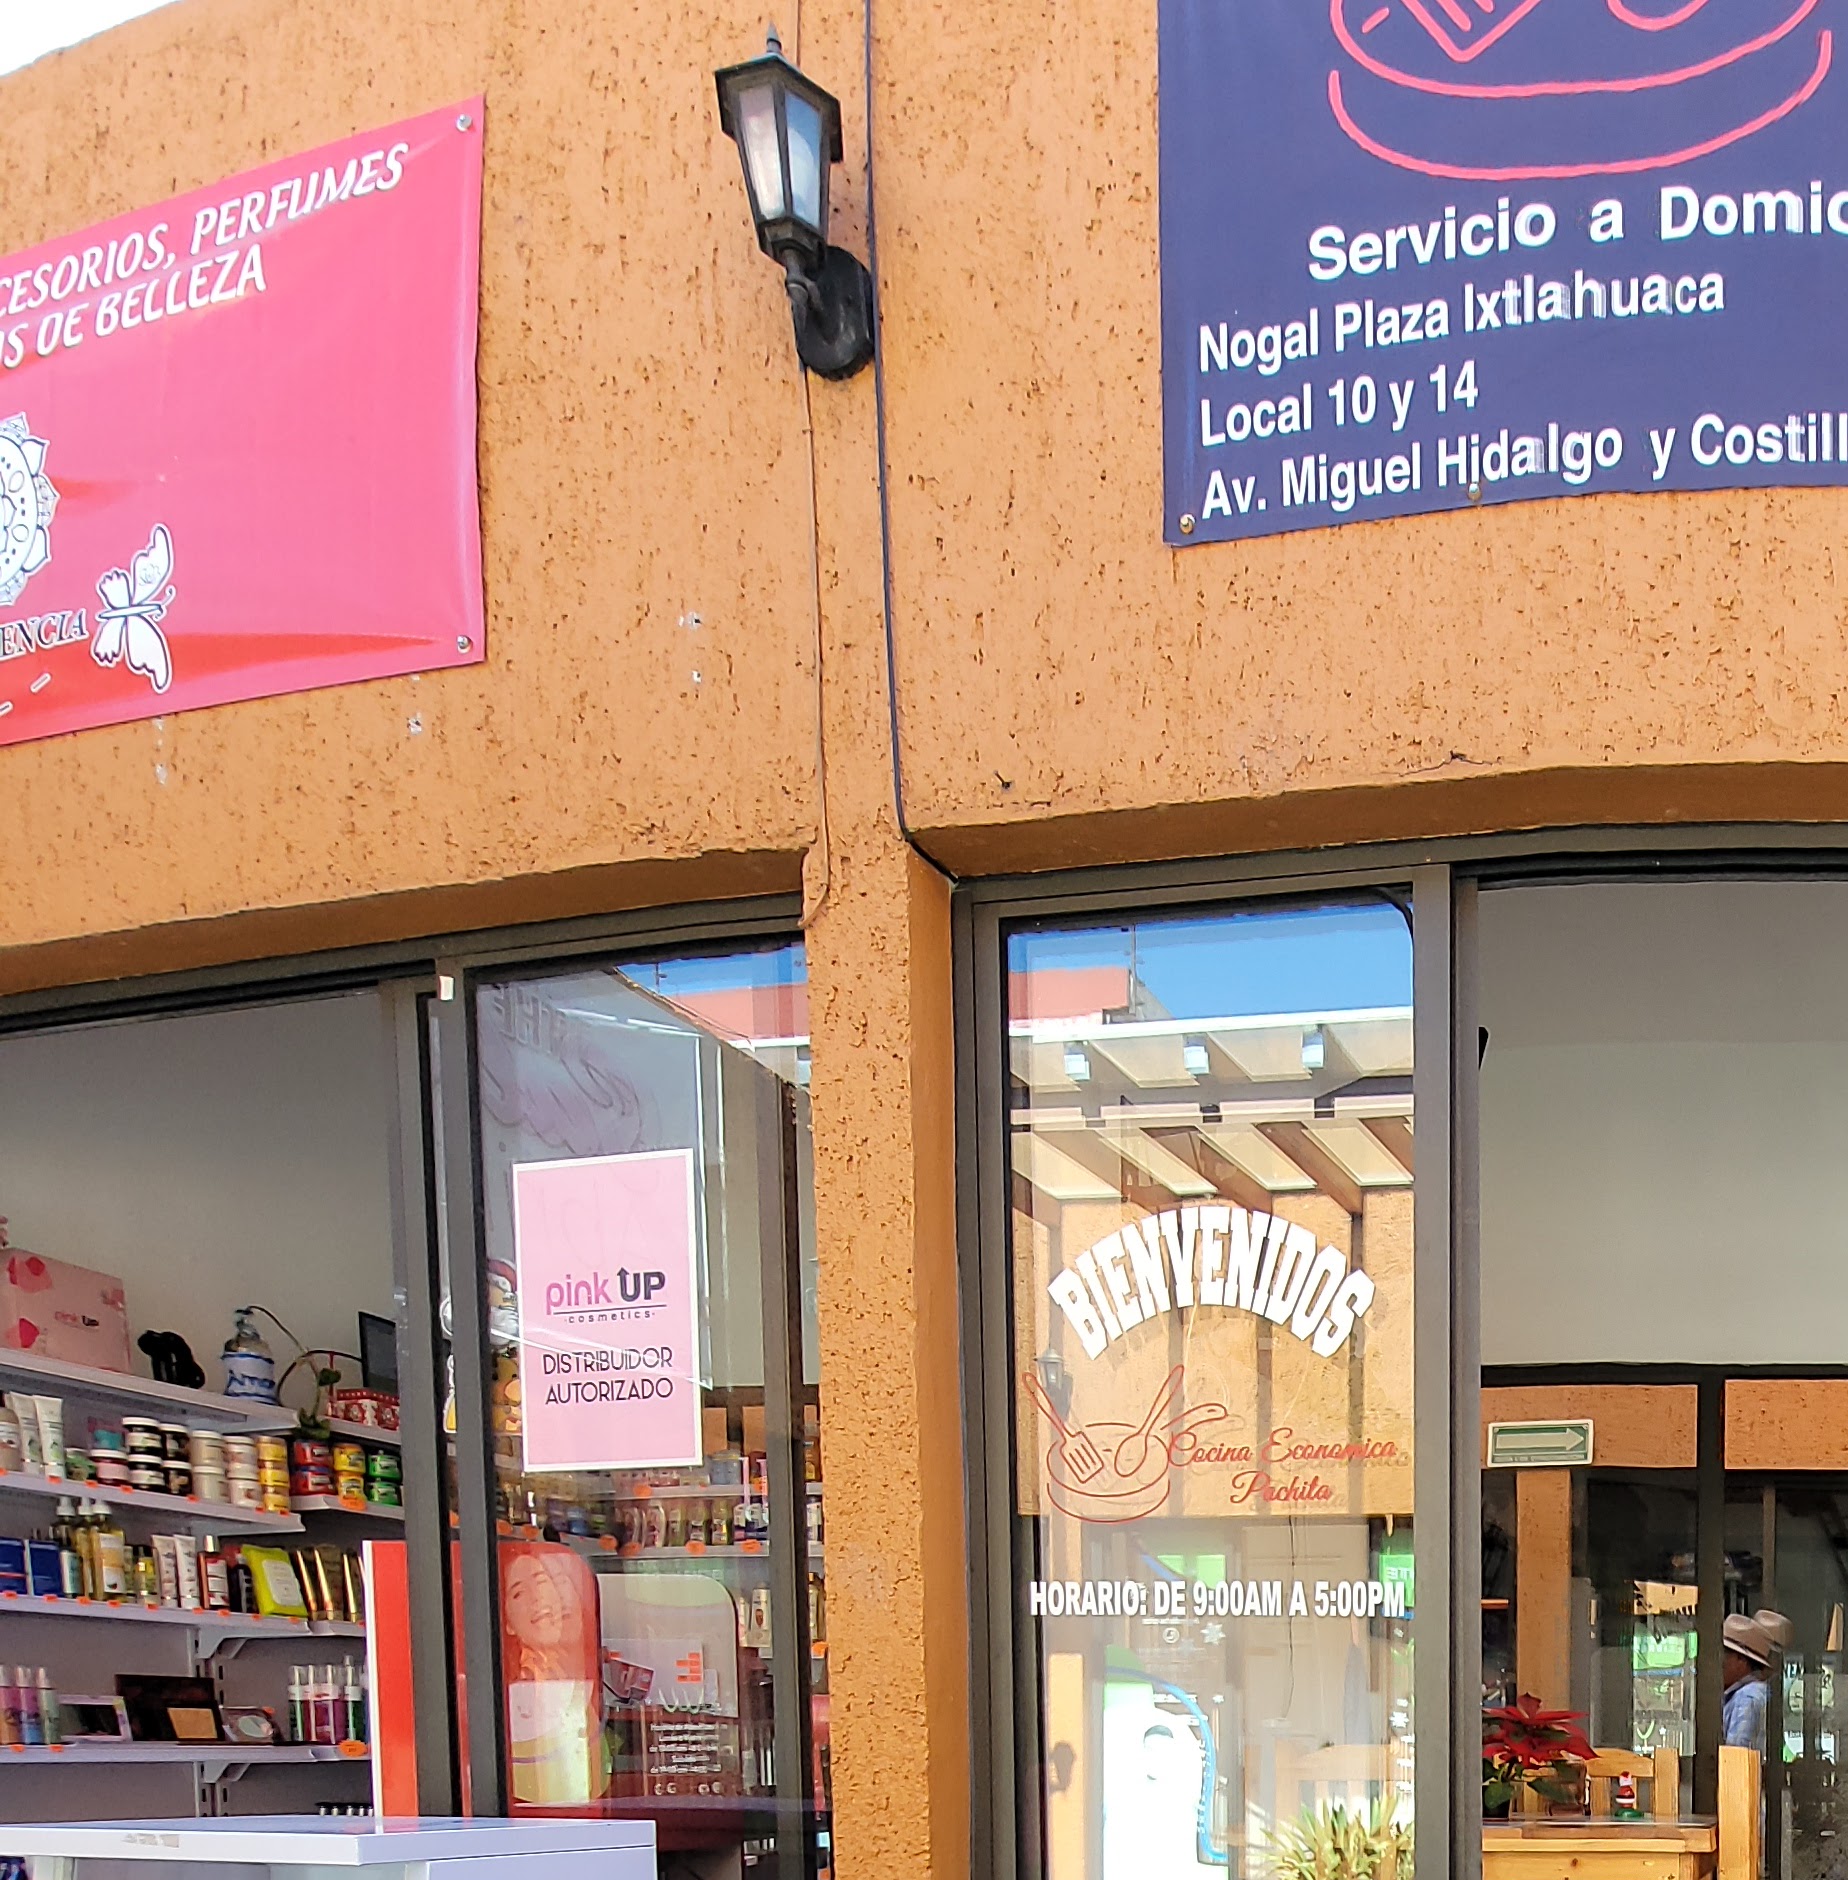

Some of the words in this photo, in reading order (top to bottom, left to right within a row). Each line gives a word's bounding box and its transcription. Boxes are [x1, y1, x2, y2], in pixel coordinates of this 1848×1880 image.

[190, 142, 410, 257] PERFUMES
[1308, 197, 1555, 281] Servicio
[1589, 198, 1624, 242] a
[36, 303, 89, 357] DE
[95, 243, 267, 338] BELLEZA
[1199, 307, 1320, 376] Nogal
[1334, 297, 1449, 353] Plaza
[1464, 270, 1724, 334] Ixtlahuaca
[1201, 383, 1312, 447] Local
[1328, 374, 1377, 428] 10
[1389, 378, 1415, 432] y
[1429, 360, 1479, 411] 14
[1201, 468, 1267, 521] Av.
[1282, 443, 1422, 514] Miguel
[1437, 423, 1624, 489] Hidalgo
[1649, 424, 1677, 480] y
[546, 1272, 612, 1315] pink
[617, 1267, 666, 1302] UP
[1047, 1206, 1375, 1361] BIENVENIDOS
[543, 1347, 673, 1375] DISTRIBUIDOR
[545, 1378, 673, 1405] AUTORIZADO
[1168, 1431, 1253, 1467] Cocina
[1261, 1427, 1398, 1464] Economica
[1230, 1471, 1333, 1503] Pachita
[1030, 1581, 1147, 1617] HORARIO:
[1155, 1581, 1186, 1616] DE
[1194, 1580, 1281, 1617] 9:00AM
[1288, 1581, 1306, 1617] A
[1314, 1581, 1405, 1617] 5:00PM
